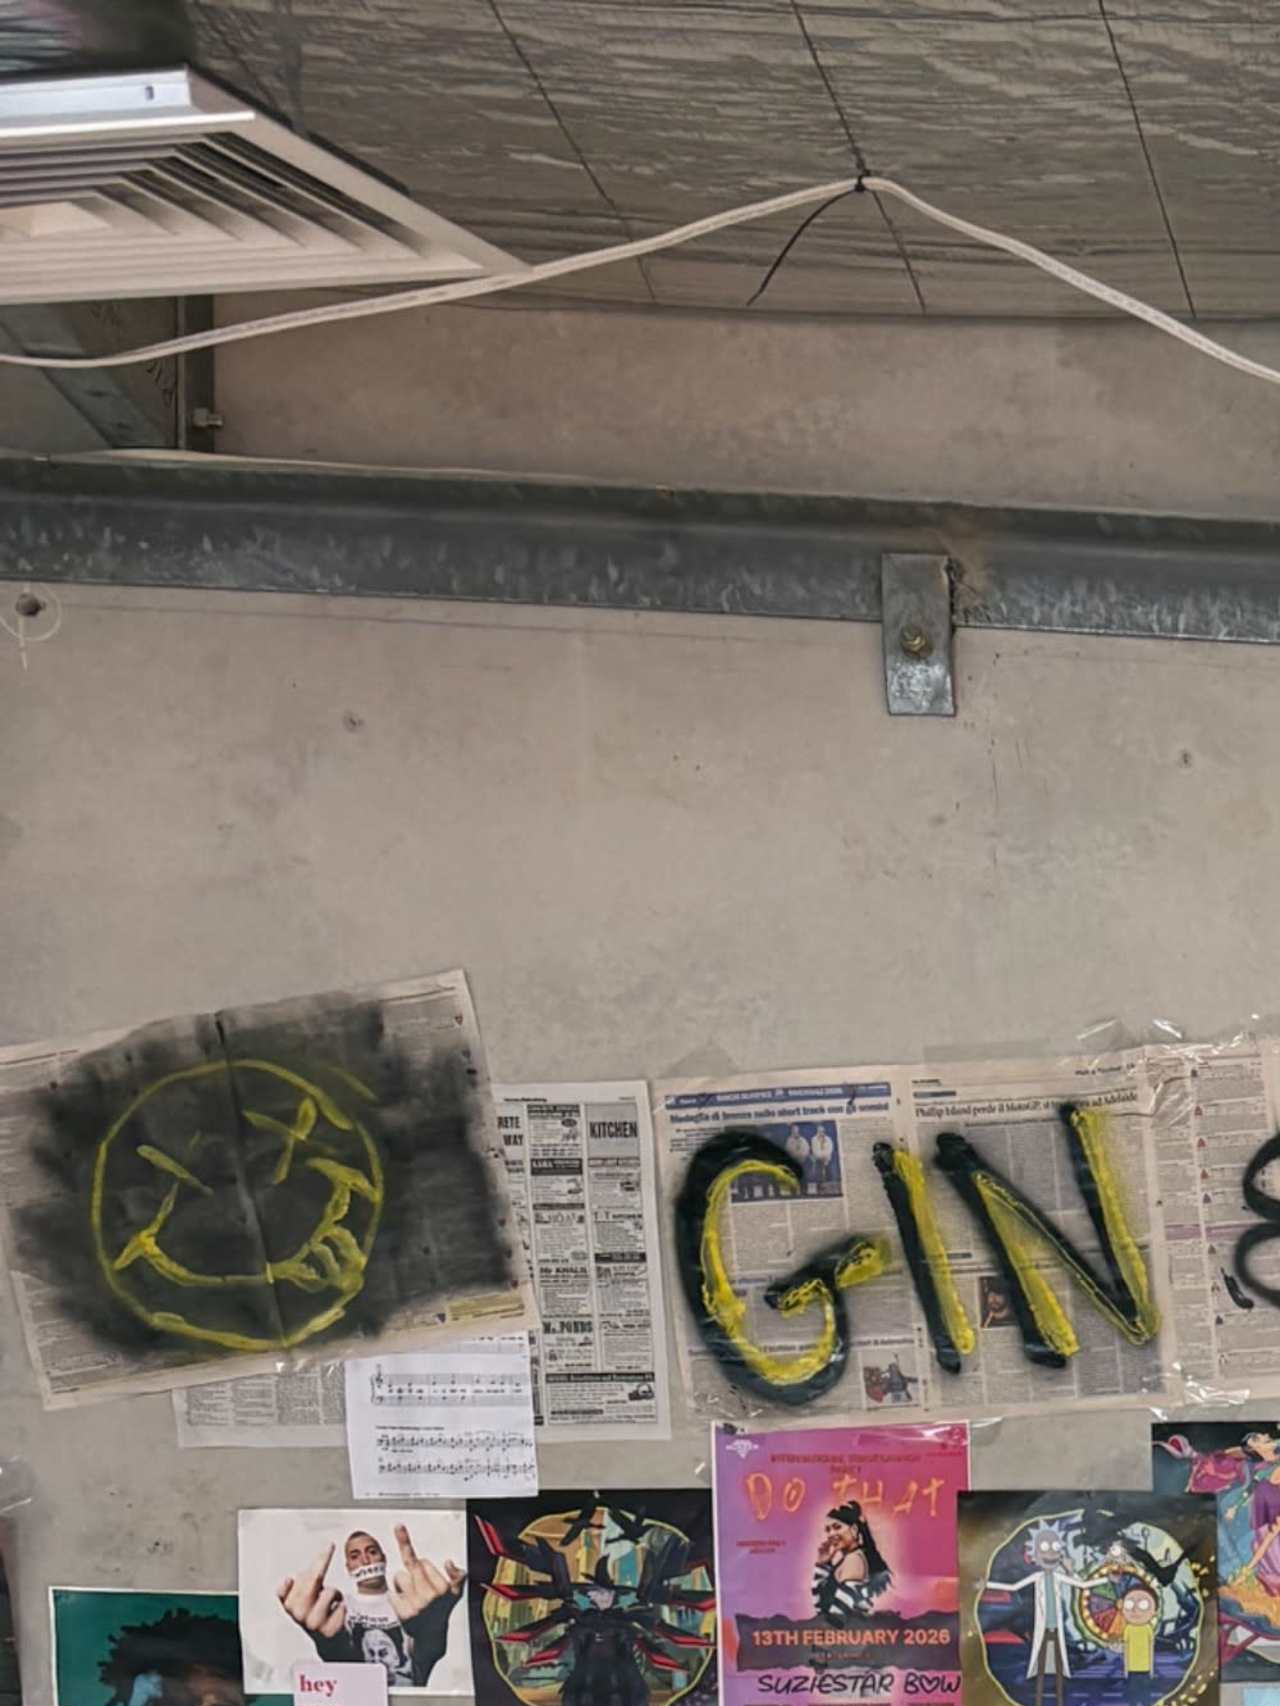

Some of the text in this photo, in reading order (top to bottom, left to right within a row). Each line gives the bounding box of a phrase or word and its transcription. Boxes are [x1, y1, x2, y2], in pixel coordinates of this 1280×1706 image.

[589, 1121, 638, 1139] KITCHEN
[676, 1104, 1161, 1404] GIN
[752, 1628, 950, 1646] 13TH FEBRUARY 2026
[299, 1674, 338, 1698] hey
[757, 1672, 895, 1695] SUZIESTAR
